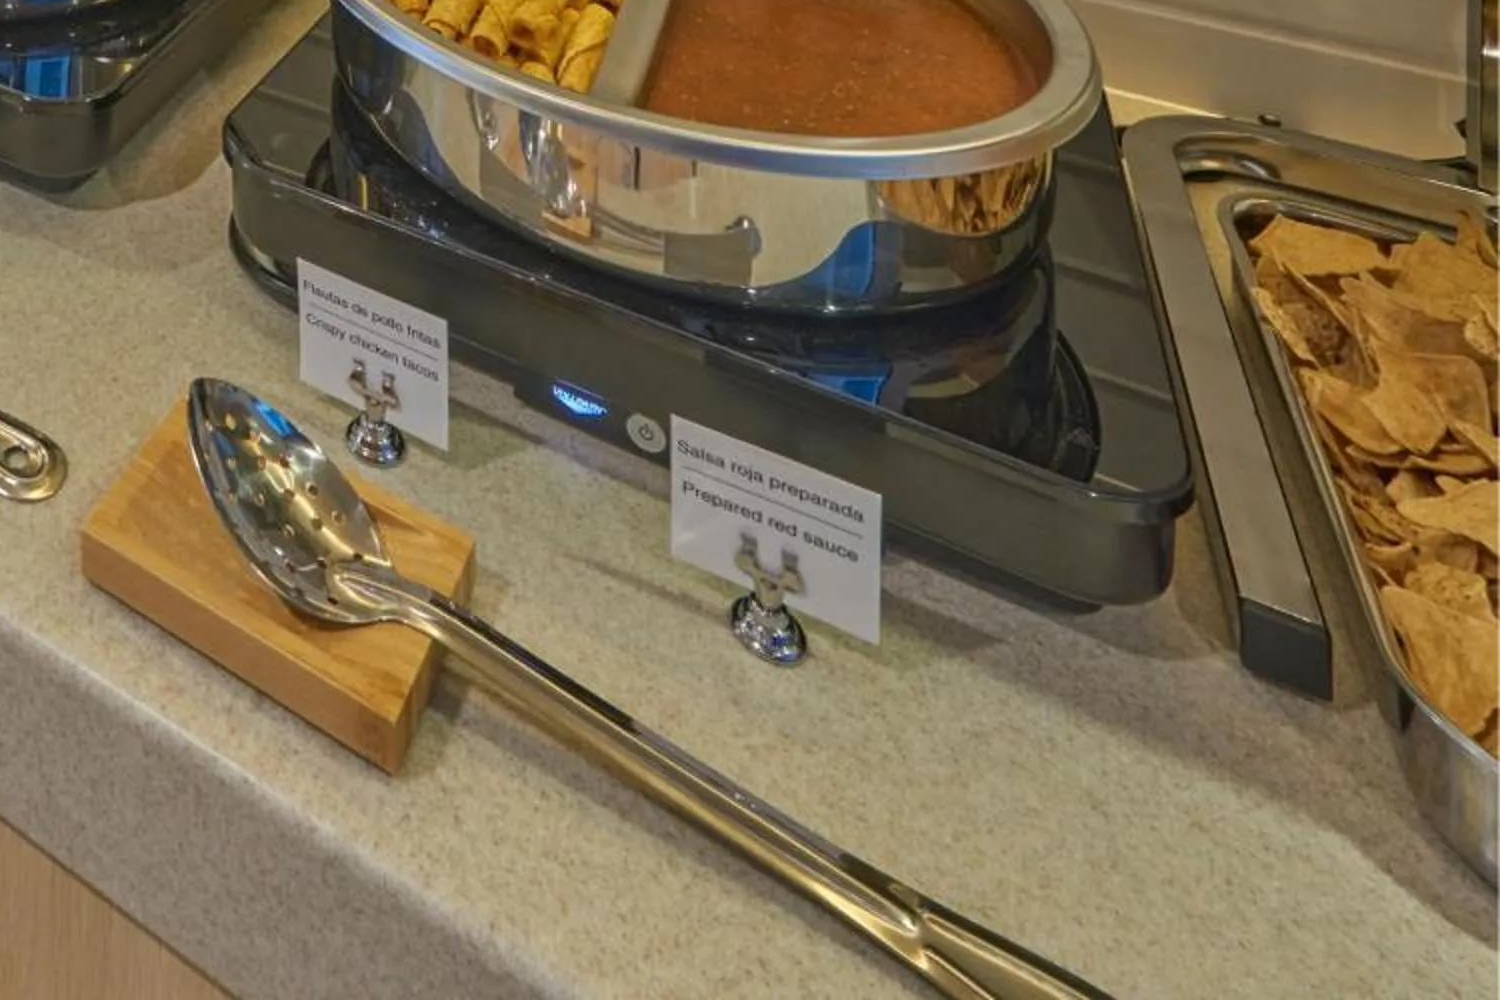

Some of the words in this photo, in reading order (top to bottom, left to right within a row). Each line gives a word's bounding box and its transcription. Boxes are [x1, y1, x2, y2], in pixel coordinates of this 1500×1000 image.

[303, 279, 349, 309] Flautas
[351, 303, 368, 318] de
[371, 312, 404, 333] pollo
[406, 324, 442, 350] fritas
[305, 313, 347, 342] Crispy
[349, 334, 399, 366] chicken
[402, 357, 440, 383] tacos
[676, 440, 726, 469] Salsa
[731, 461, 764, 484] roja
[769, 478, 865, 524] preparada
[682, 480, 764, 524] Prepared
[768, 516, 798, 538] red
[803, 532, 860, 563] sauce
